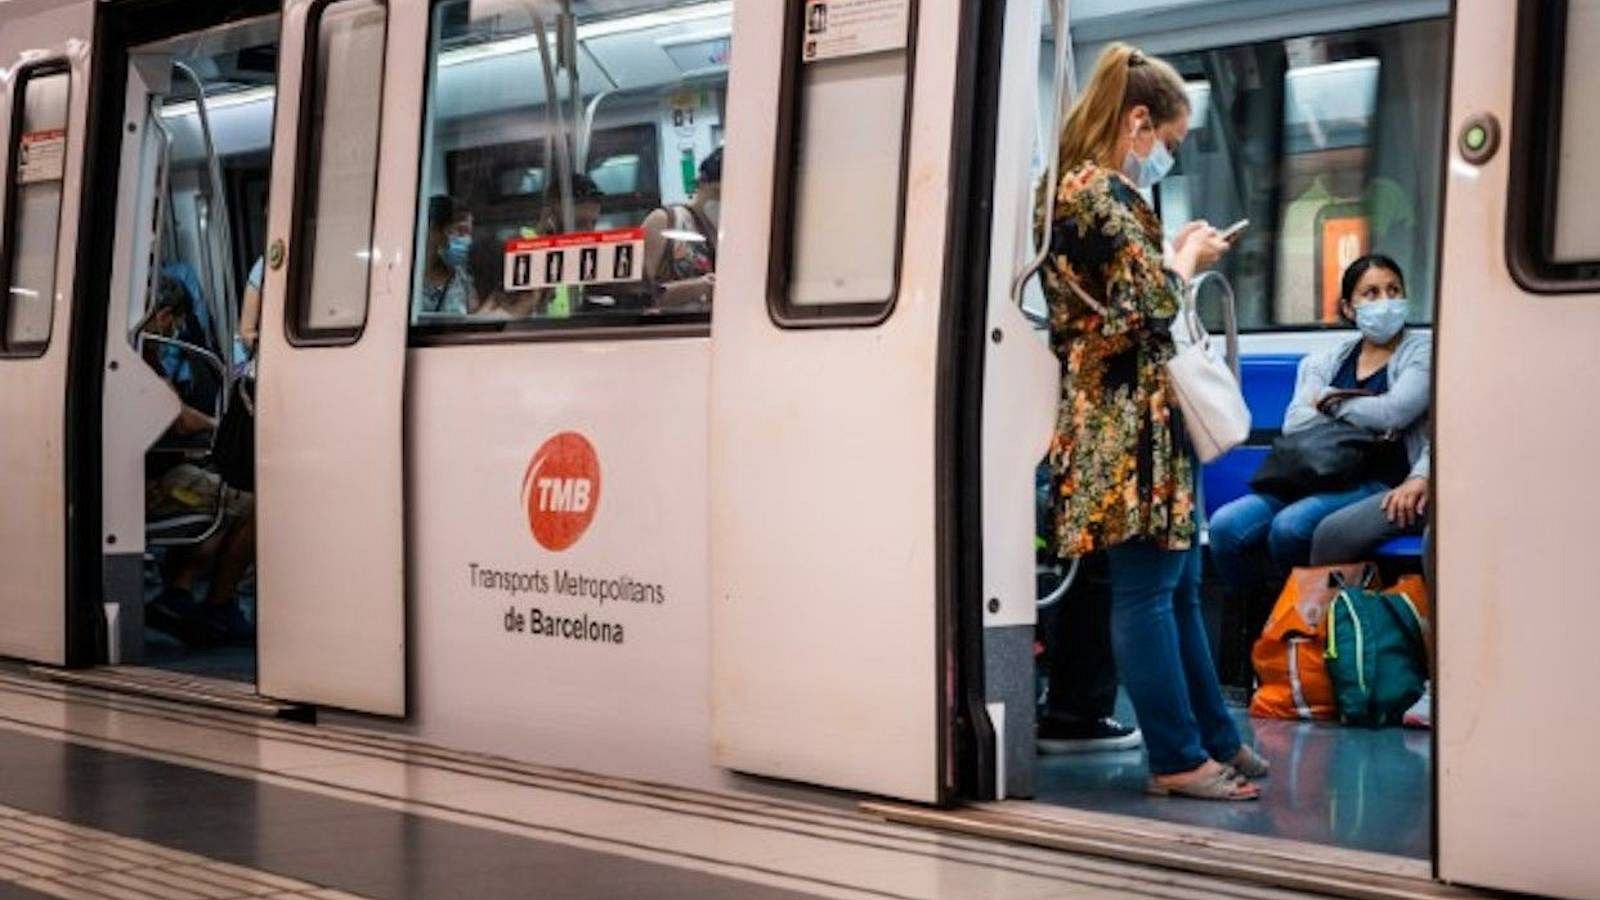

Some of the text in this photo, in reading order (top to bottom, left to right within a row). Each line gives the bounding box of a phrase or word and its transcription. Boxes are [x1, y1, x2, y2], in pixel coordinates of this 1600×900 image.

[537, 478, 592, 512] TMB
[469, 563, 665, 605] Transports Metropolitans
[504, 606, 624, 644] de Barcelona
